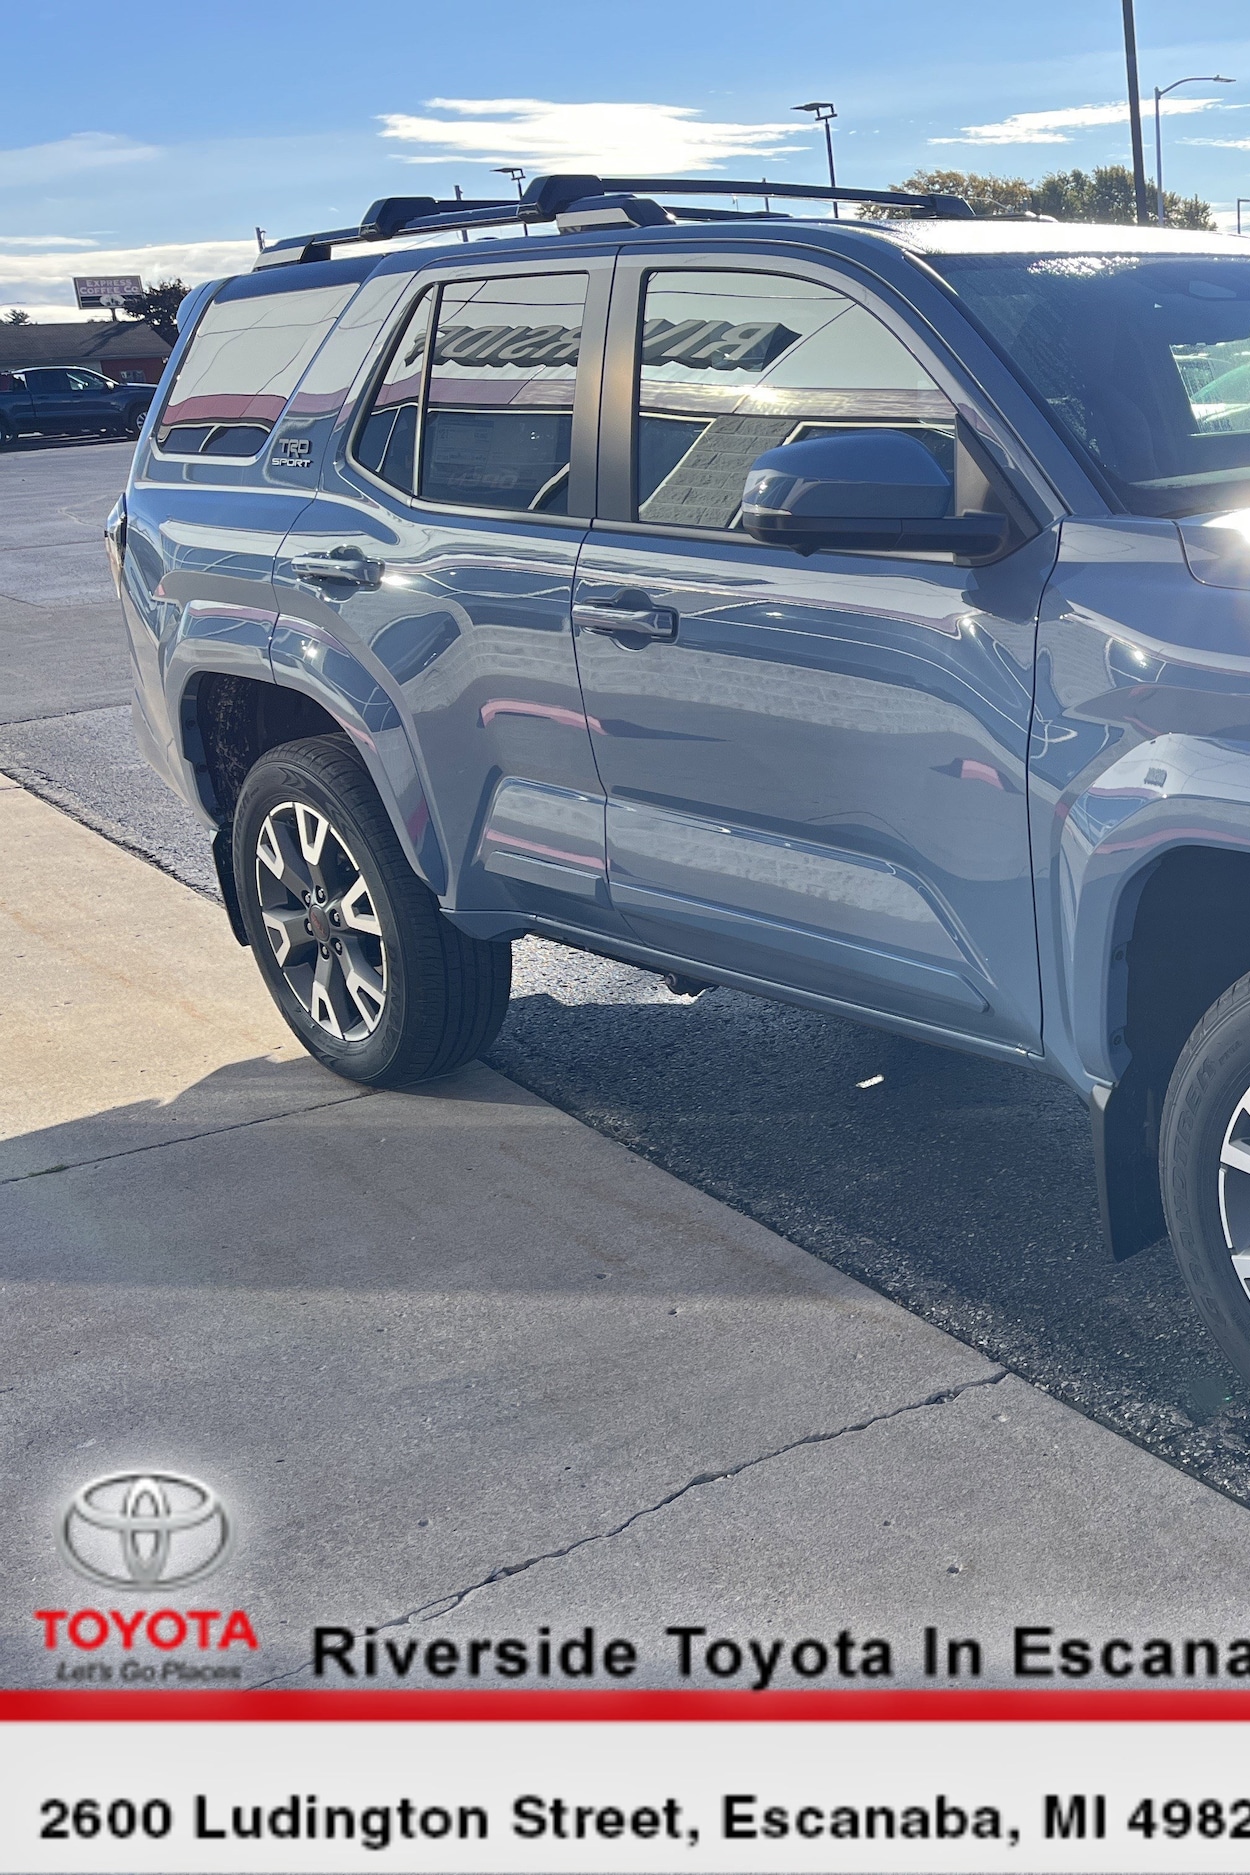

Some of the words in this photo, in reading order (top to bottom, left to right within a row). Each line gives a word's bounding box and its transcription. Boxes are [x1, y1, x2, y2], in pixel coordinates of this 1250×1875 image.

[86, 279, 132, 287] EXPRESS
[80, 287, 120, 295] COFFEE
[279, 439, 309, 458] TRD
[272, 457, 310, 467] SPORT
